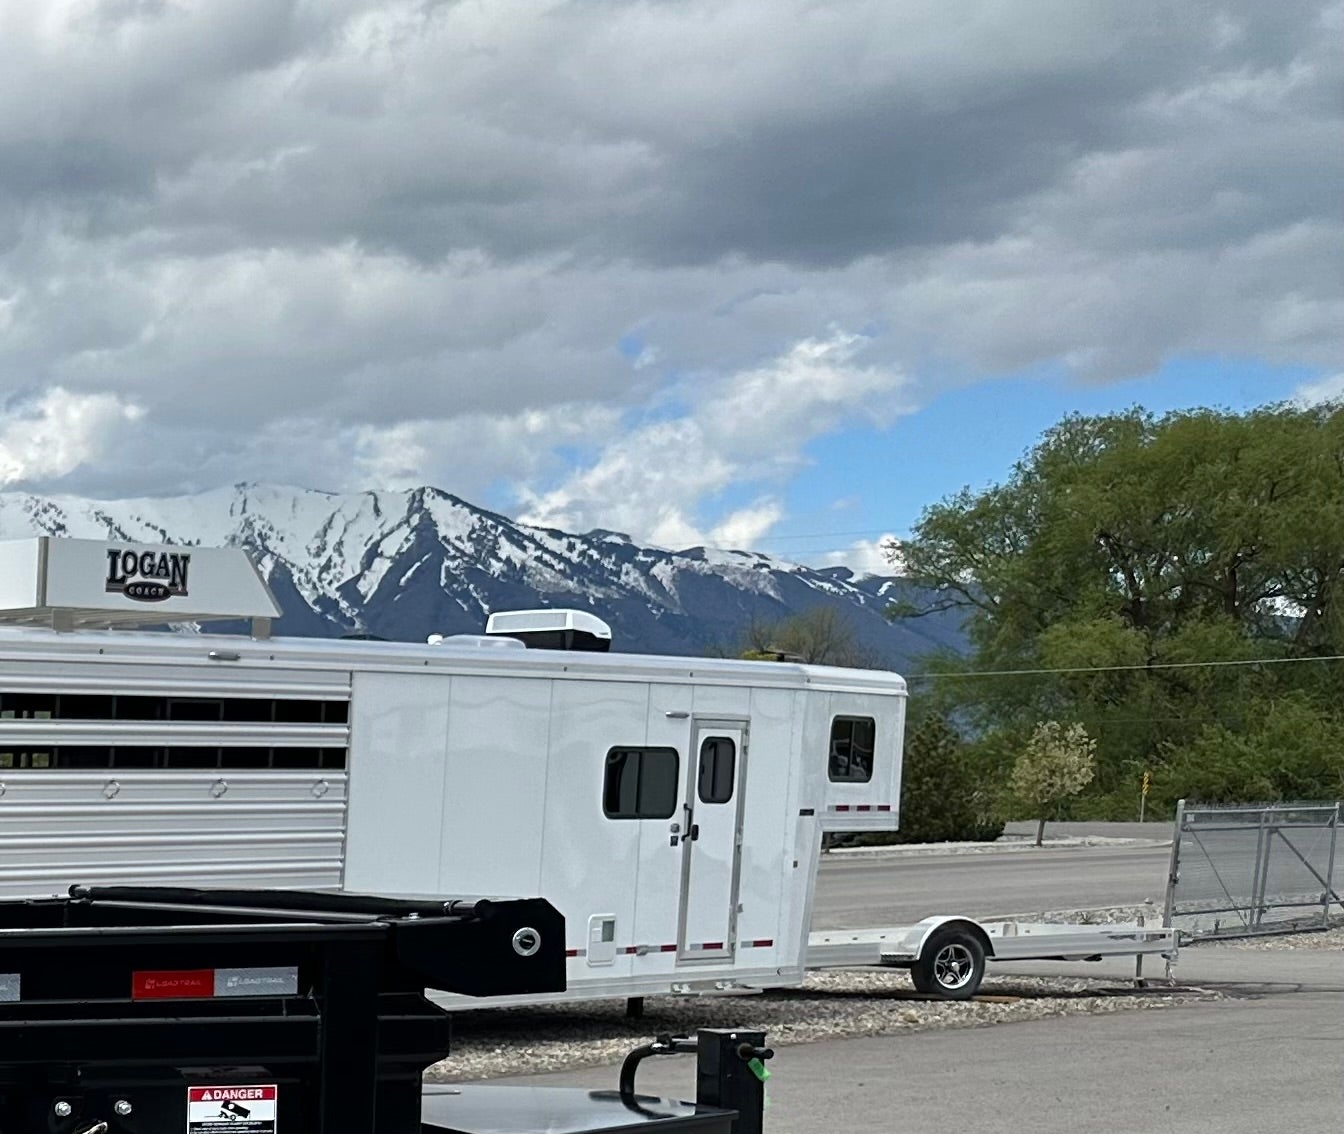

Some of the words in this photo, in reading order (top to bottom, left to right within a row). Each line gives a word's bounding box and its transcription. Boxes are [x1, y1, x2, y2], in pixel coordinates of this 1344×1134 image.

[106, 549, 191, 592] LOGAN
[128, 586, 165, 596] COACH
[213, 1089, 263, 1100] DANGER
